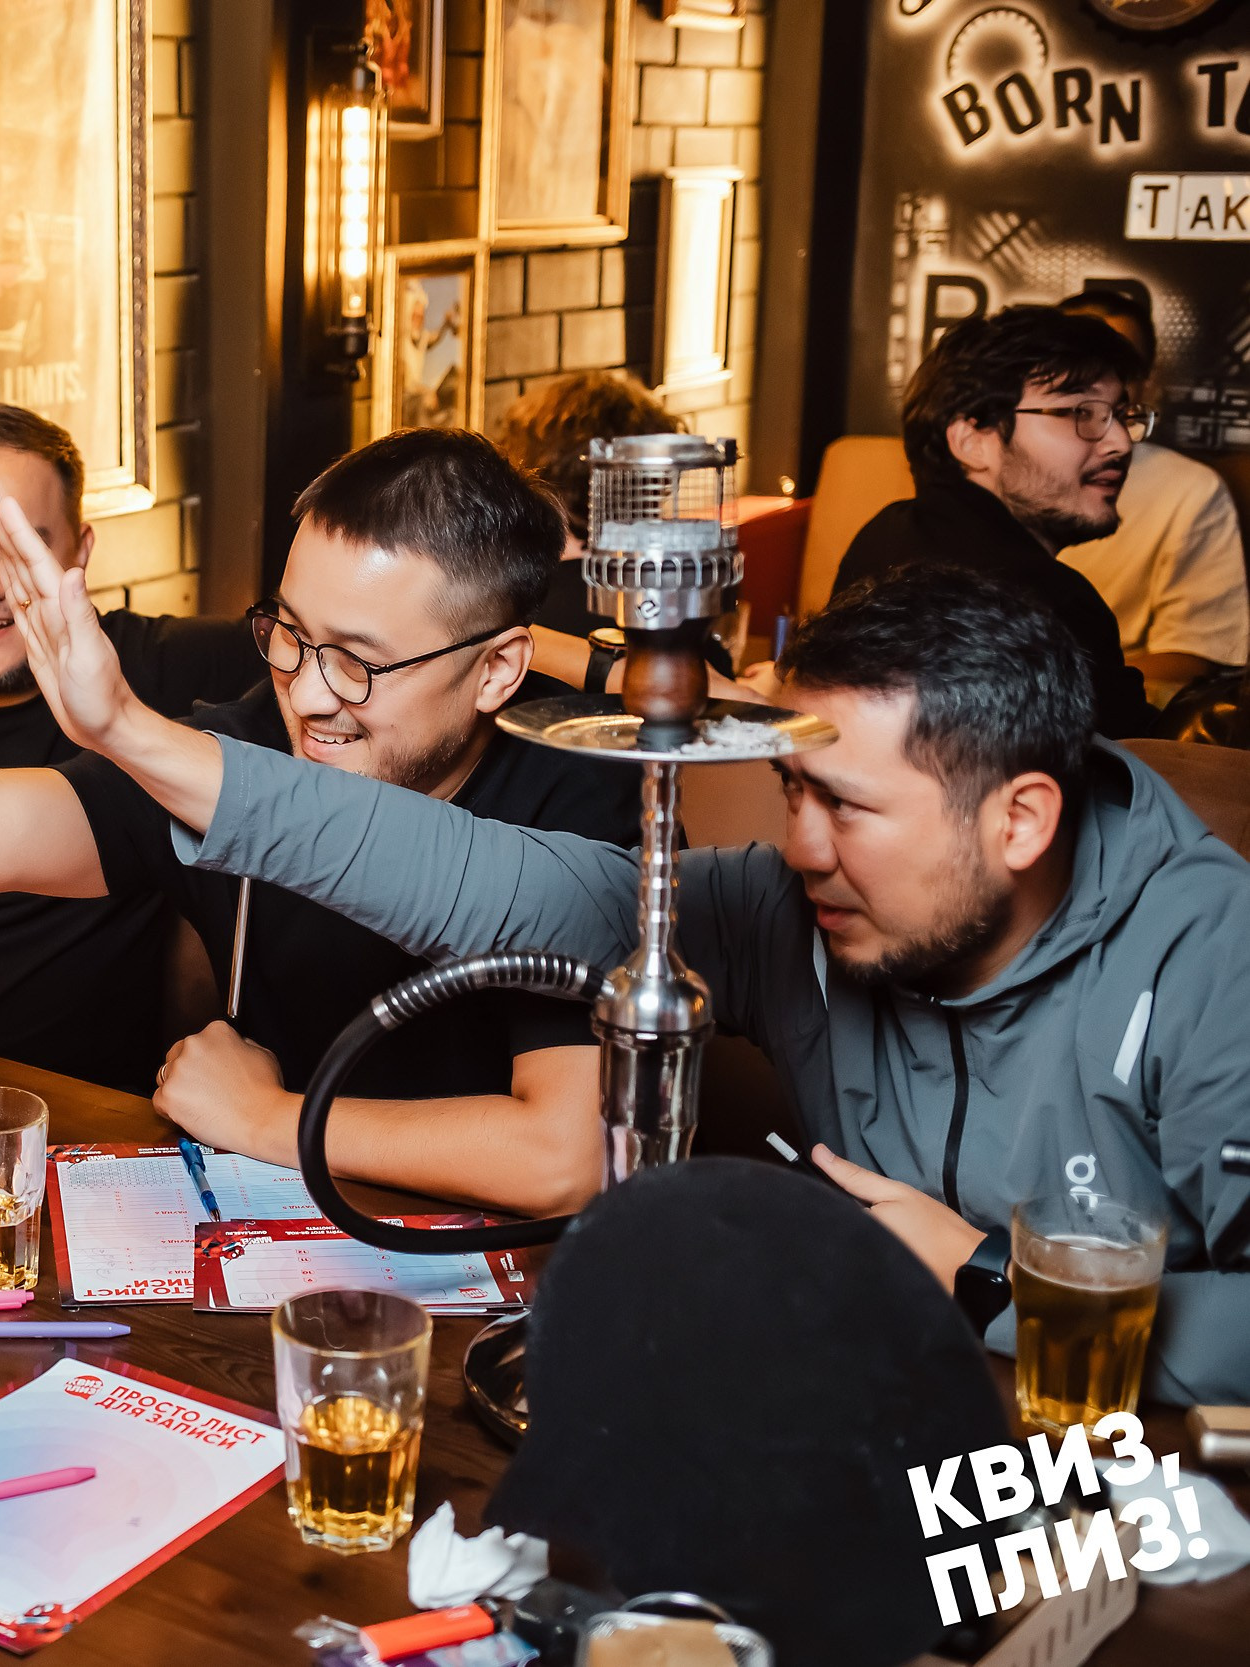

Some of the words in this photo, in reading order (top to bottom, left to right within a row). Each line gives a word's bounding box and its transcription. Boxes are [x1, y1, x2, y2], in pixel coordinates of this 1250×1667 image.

[942, 67, 1142, 146] BORN
[1143, 184, 1250, 231] TAK
[3, 360, 87, 408] LIMITS.
[238, 1235, 273, 1247] MARVEL
[83, 1287, 146, 1297] ЛИСТ
[95, 1397, 146, 1418] ДЛЯ
[145, 1413, 238, 1450] ЗАПИСИ
[110, 1385, 201, 1423] ПРОСТО
[200, 1417, 266, 1444] ЛИСТ
